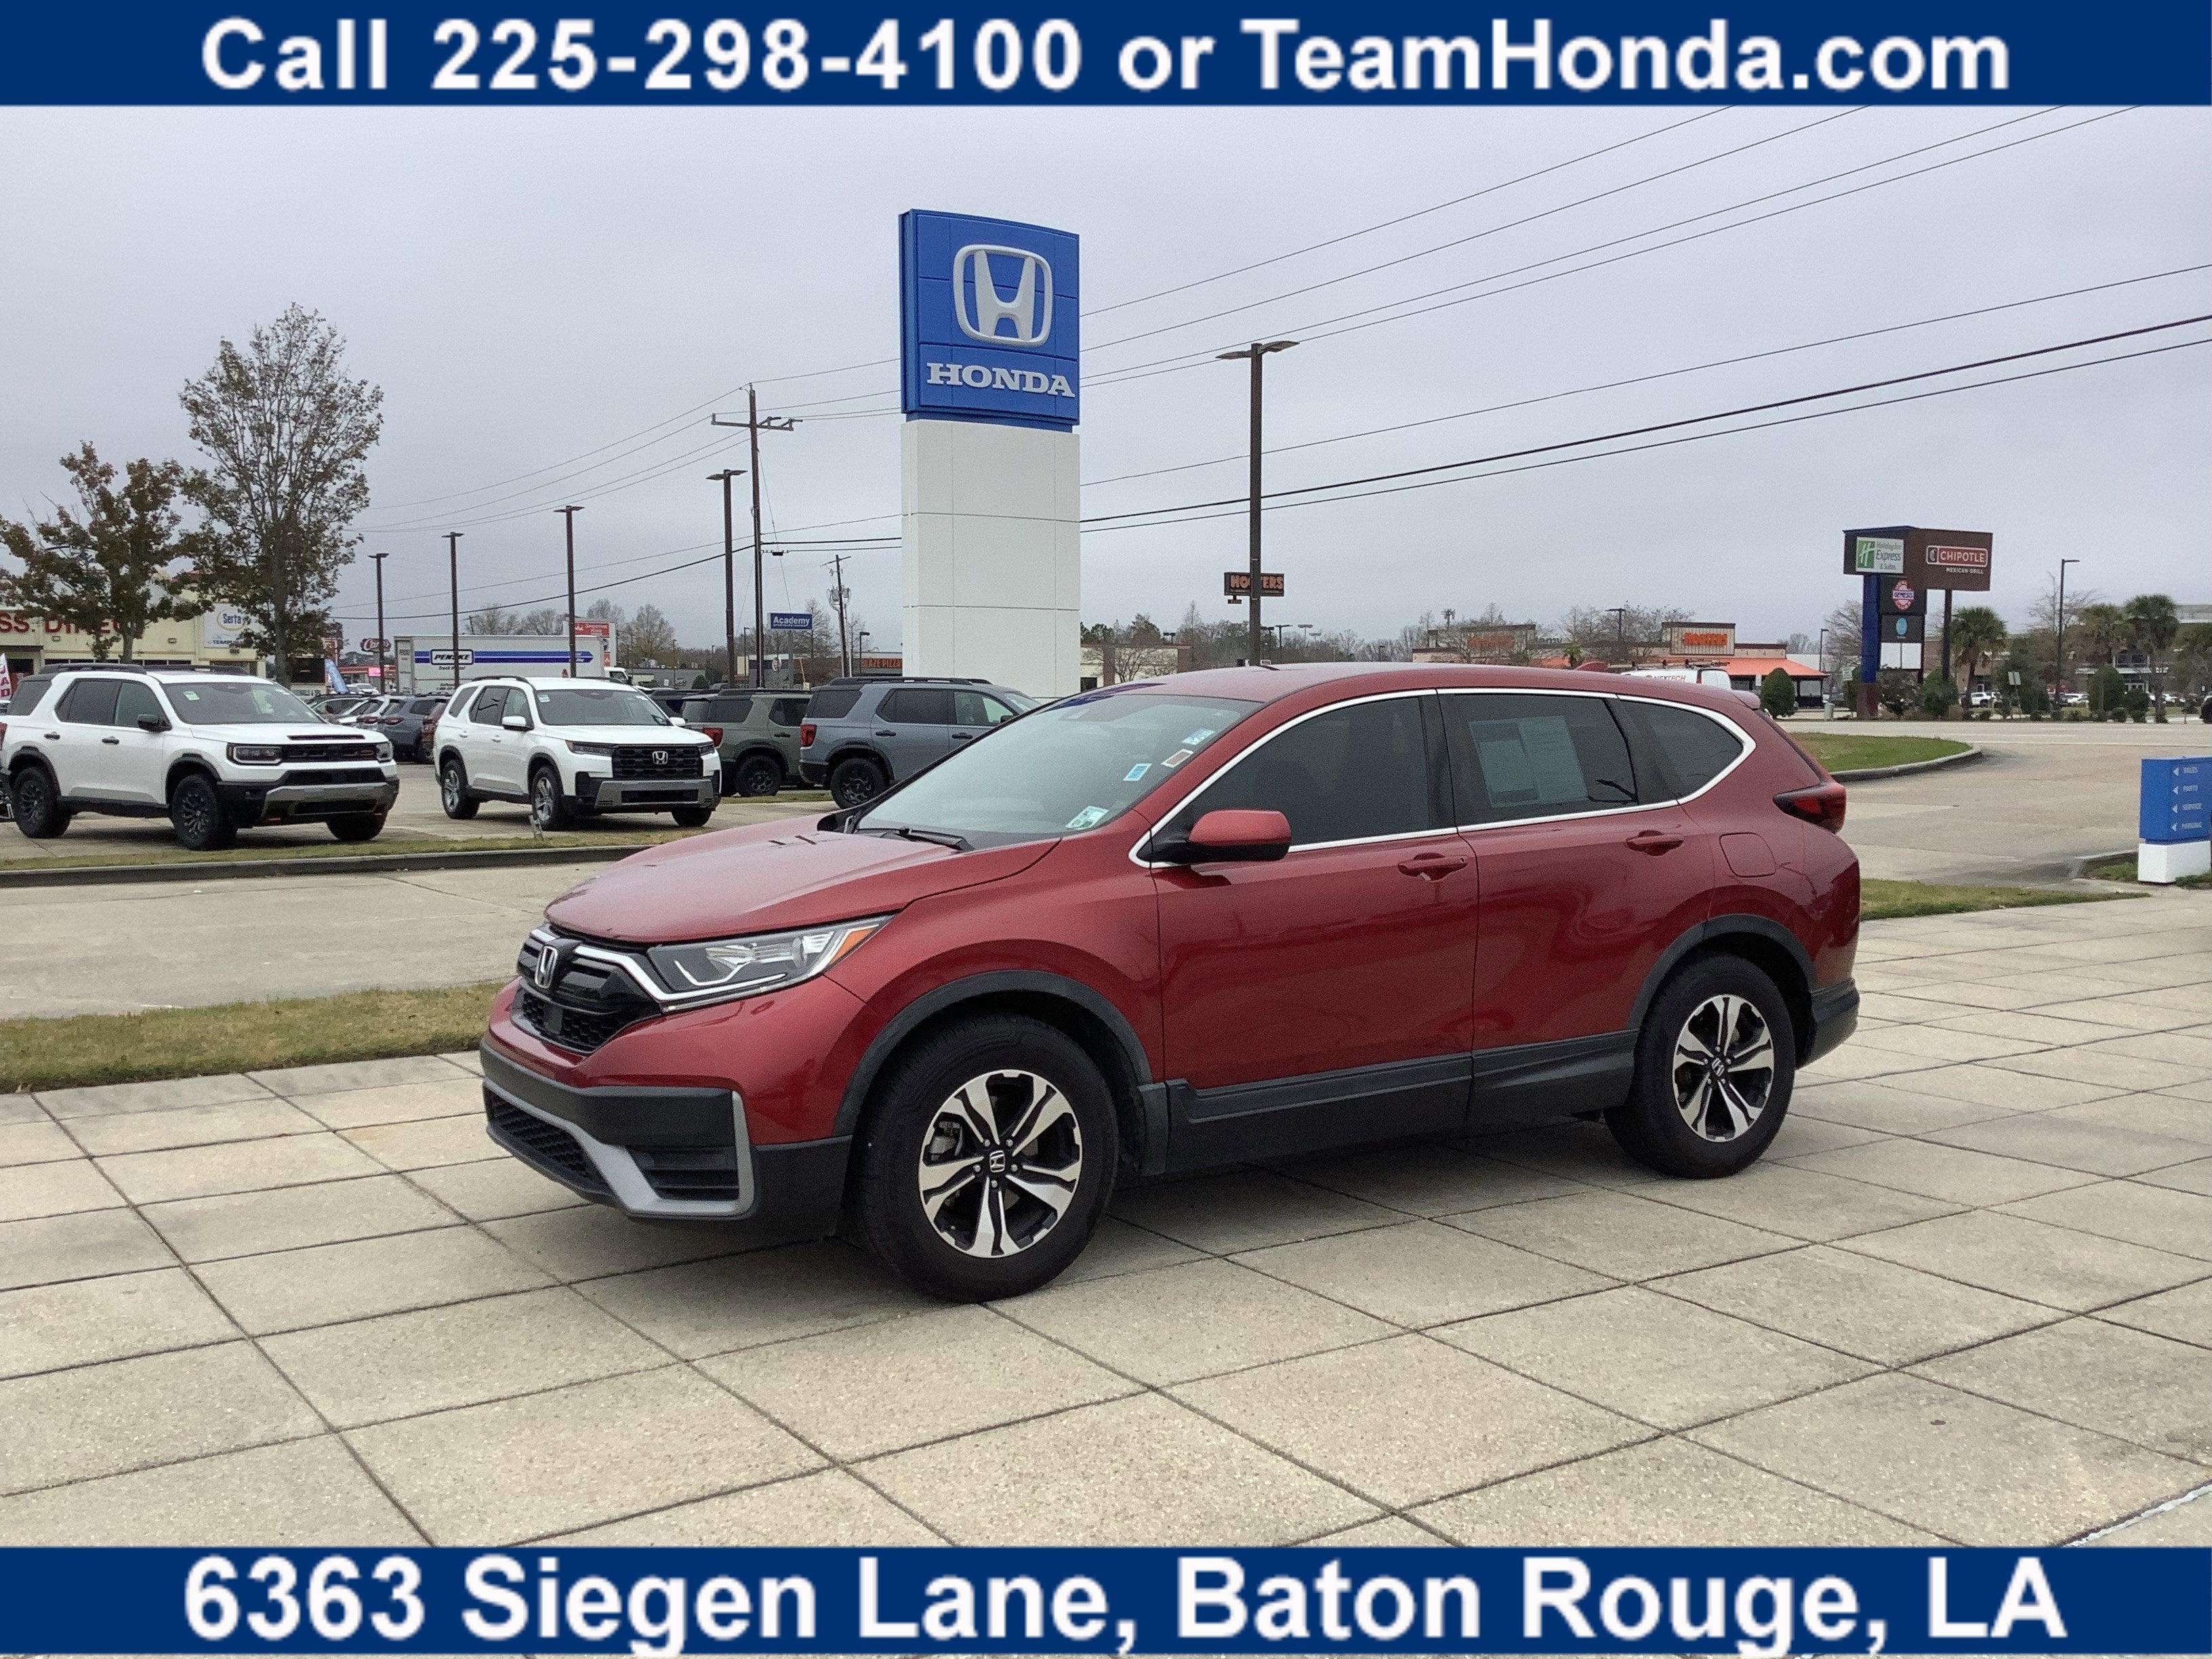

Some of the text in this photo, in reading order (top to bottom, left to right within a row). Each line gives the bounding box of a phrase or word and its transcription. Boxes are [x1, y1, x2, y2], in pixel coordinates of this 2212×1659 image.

[926, 362, 1076, 398] HONDA
[1940, 550, 1986, 563] CHIPOTLE
[1230, 575, 1283, 590] HOERS
[222, 613, 242, 624] Serta
[773, 616, 811, 628] Academy
